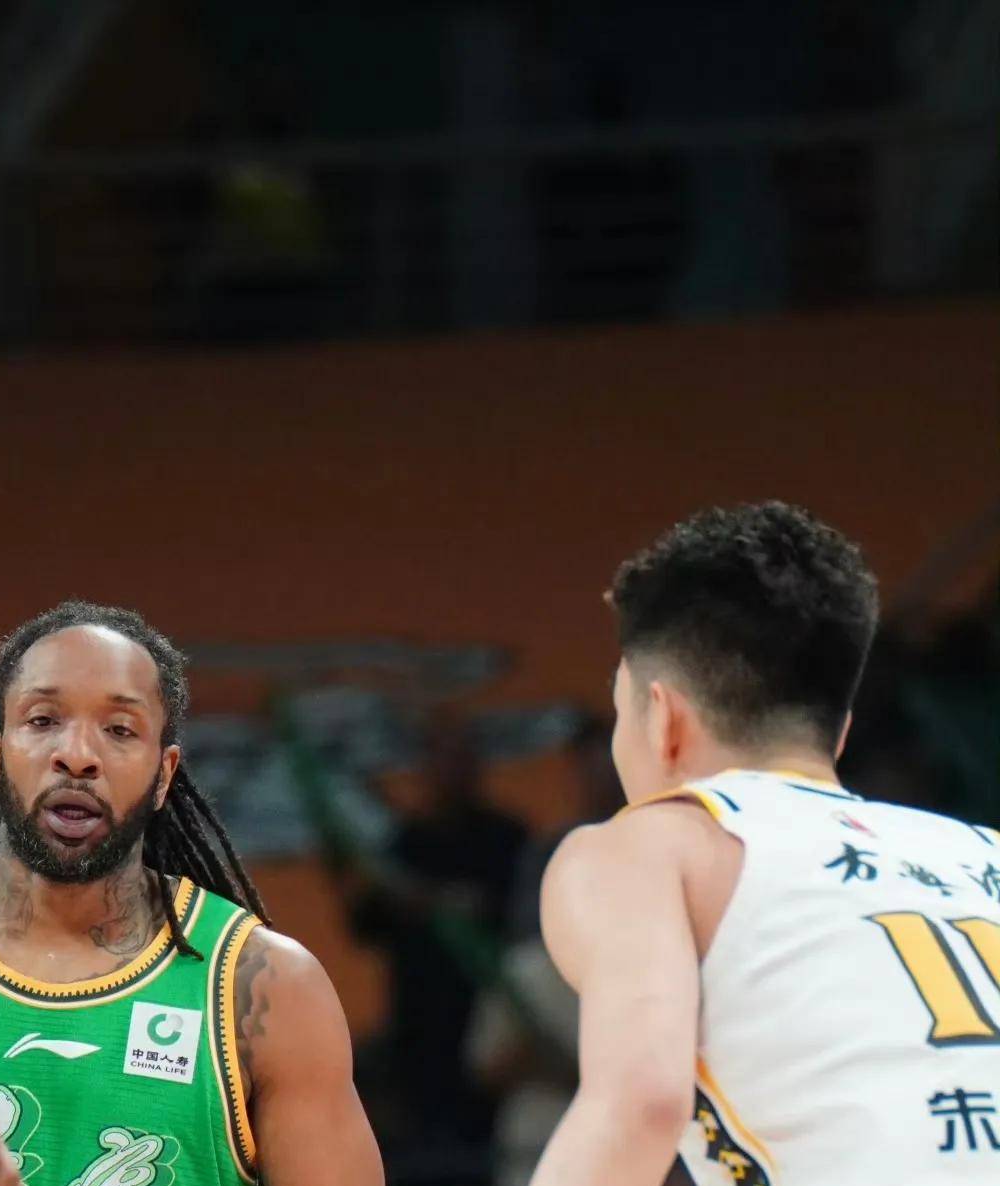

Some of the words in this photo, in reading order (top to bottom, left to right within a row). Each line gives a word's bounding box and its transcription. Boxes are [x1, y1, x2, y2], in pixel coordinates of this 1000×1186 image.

[132, 1048, 189, 1067] 中国人寿
[130, 1060, 162, 1071] CHINA
[165, 1066, 187, 1076] LIFE
[927, 1088, 1000, 1152] 朱
